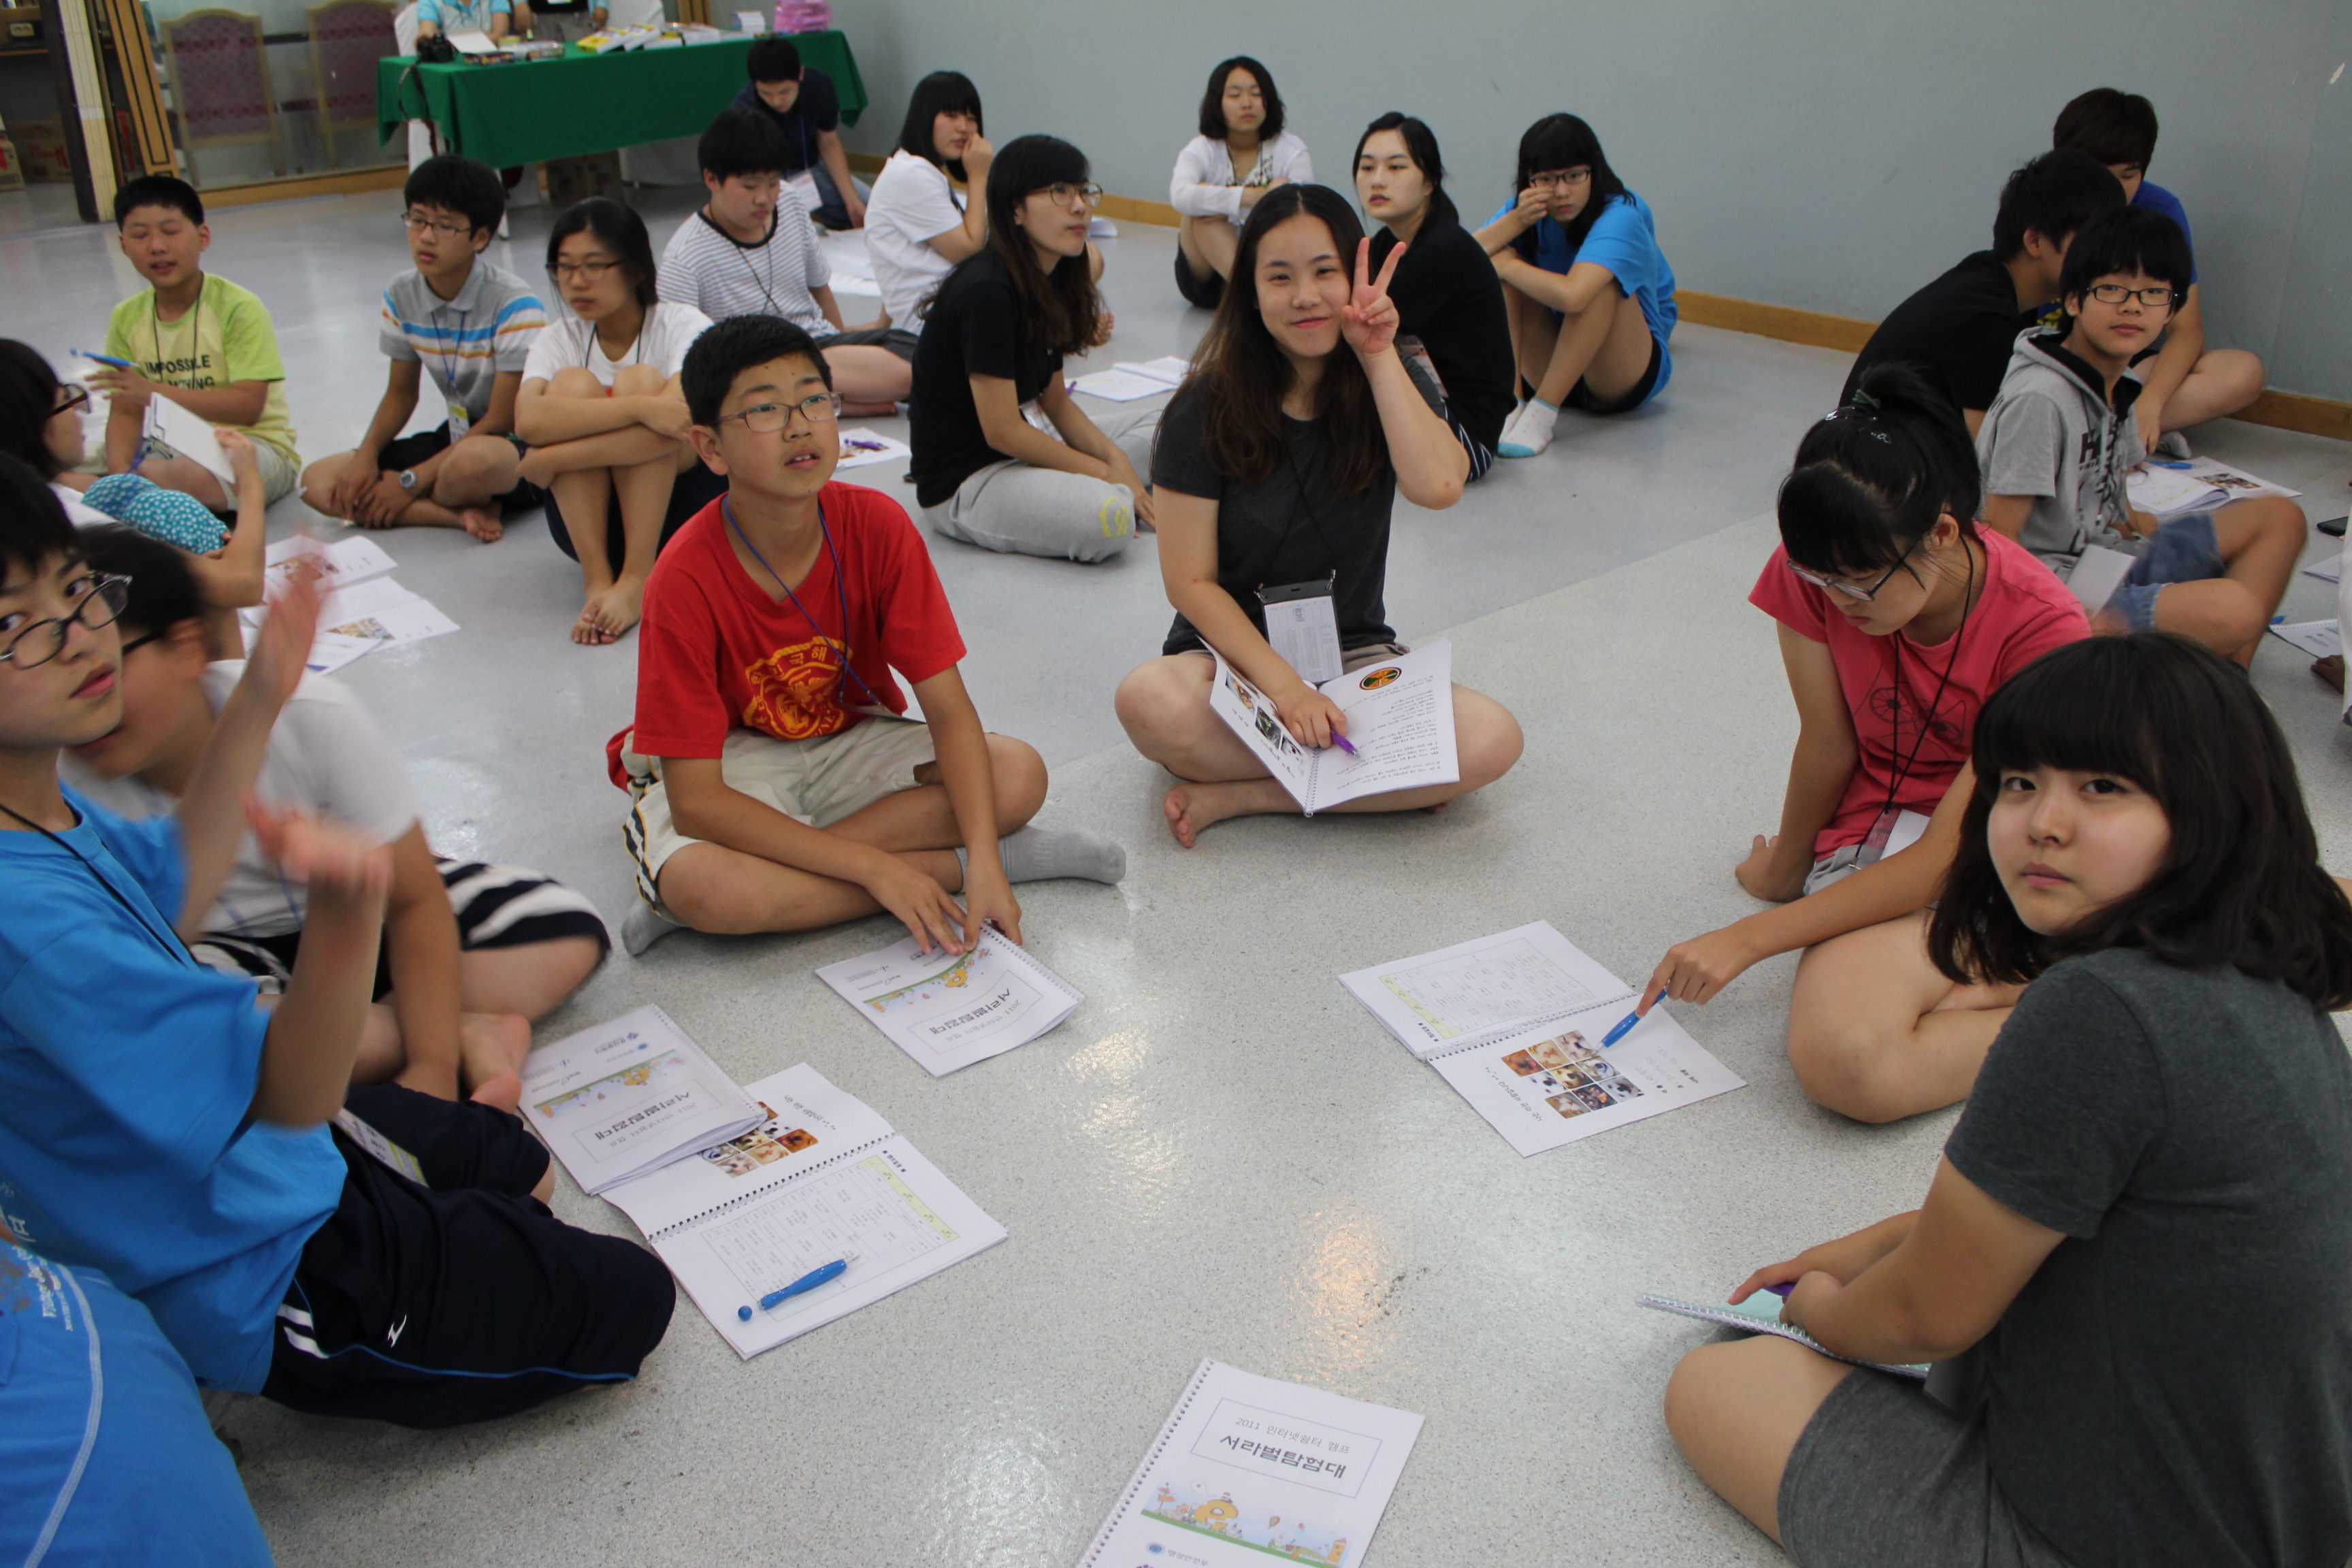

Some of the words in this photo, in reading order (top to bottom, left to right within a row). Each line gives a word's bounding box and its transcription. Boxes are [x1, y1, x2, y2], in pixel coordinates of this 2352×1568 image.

[929, 988, 1011, 1034] 서라벌탐험대
[1004, 999, 1022, 1015] 2011
[595, 1092, 689, 1140] 서라벌탐험대
[677, 1102, 696, 1113] 2011
[1235, 1417, 1261, 1431] 2011
[1267, 1425, 1323, 1448] 인터넷쉼터
[1328, 1441, 1351, 1454] 캠프
[1220, 1435, 1347, 1480] 서라벌탐험대
